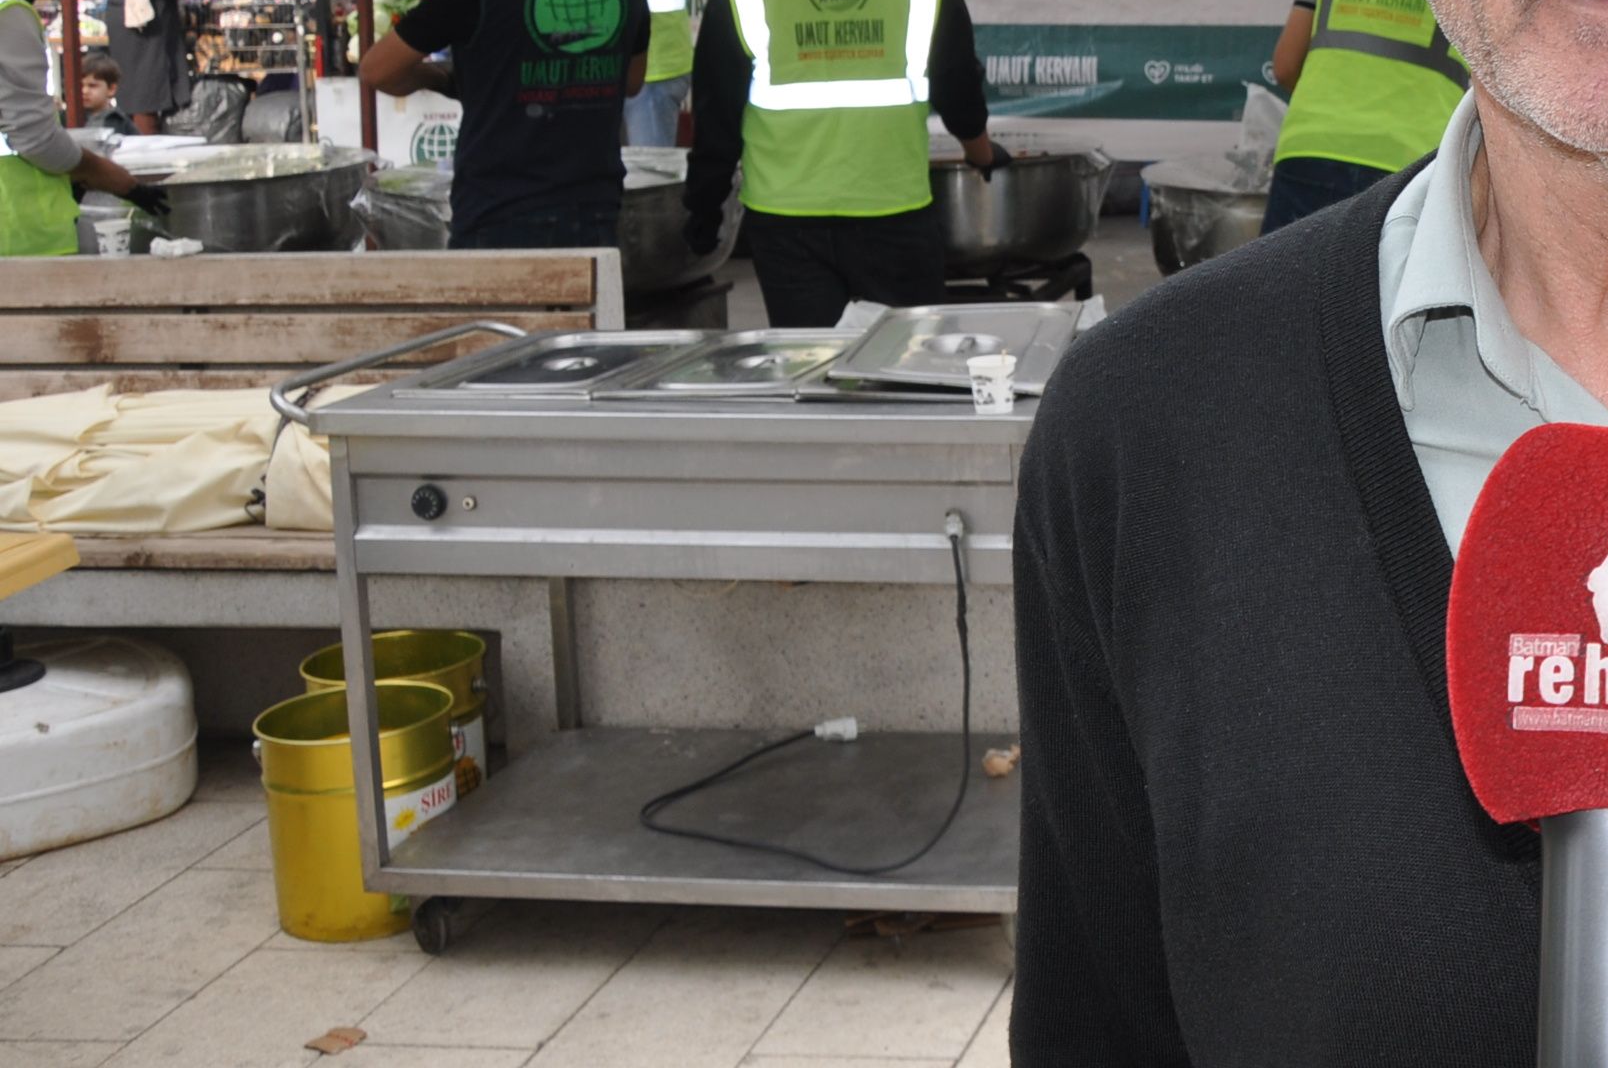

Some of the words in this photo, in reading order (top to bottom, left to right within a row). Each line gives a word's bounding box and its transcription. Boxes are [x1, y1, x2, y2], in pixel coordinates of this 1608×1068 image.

[986, 55, 1031, 85] UMUT
[1035, 55, 1099, 85] KERVANI
[1513, 635, 1579, 656] Batman
